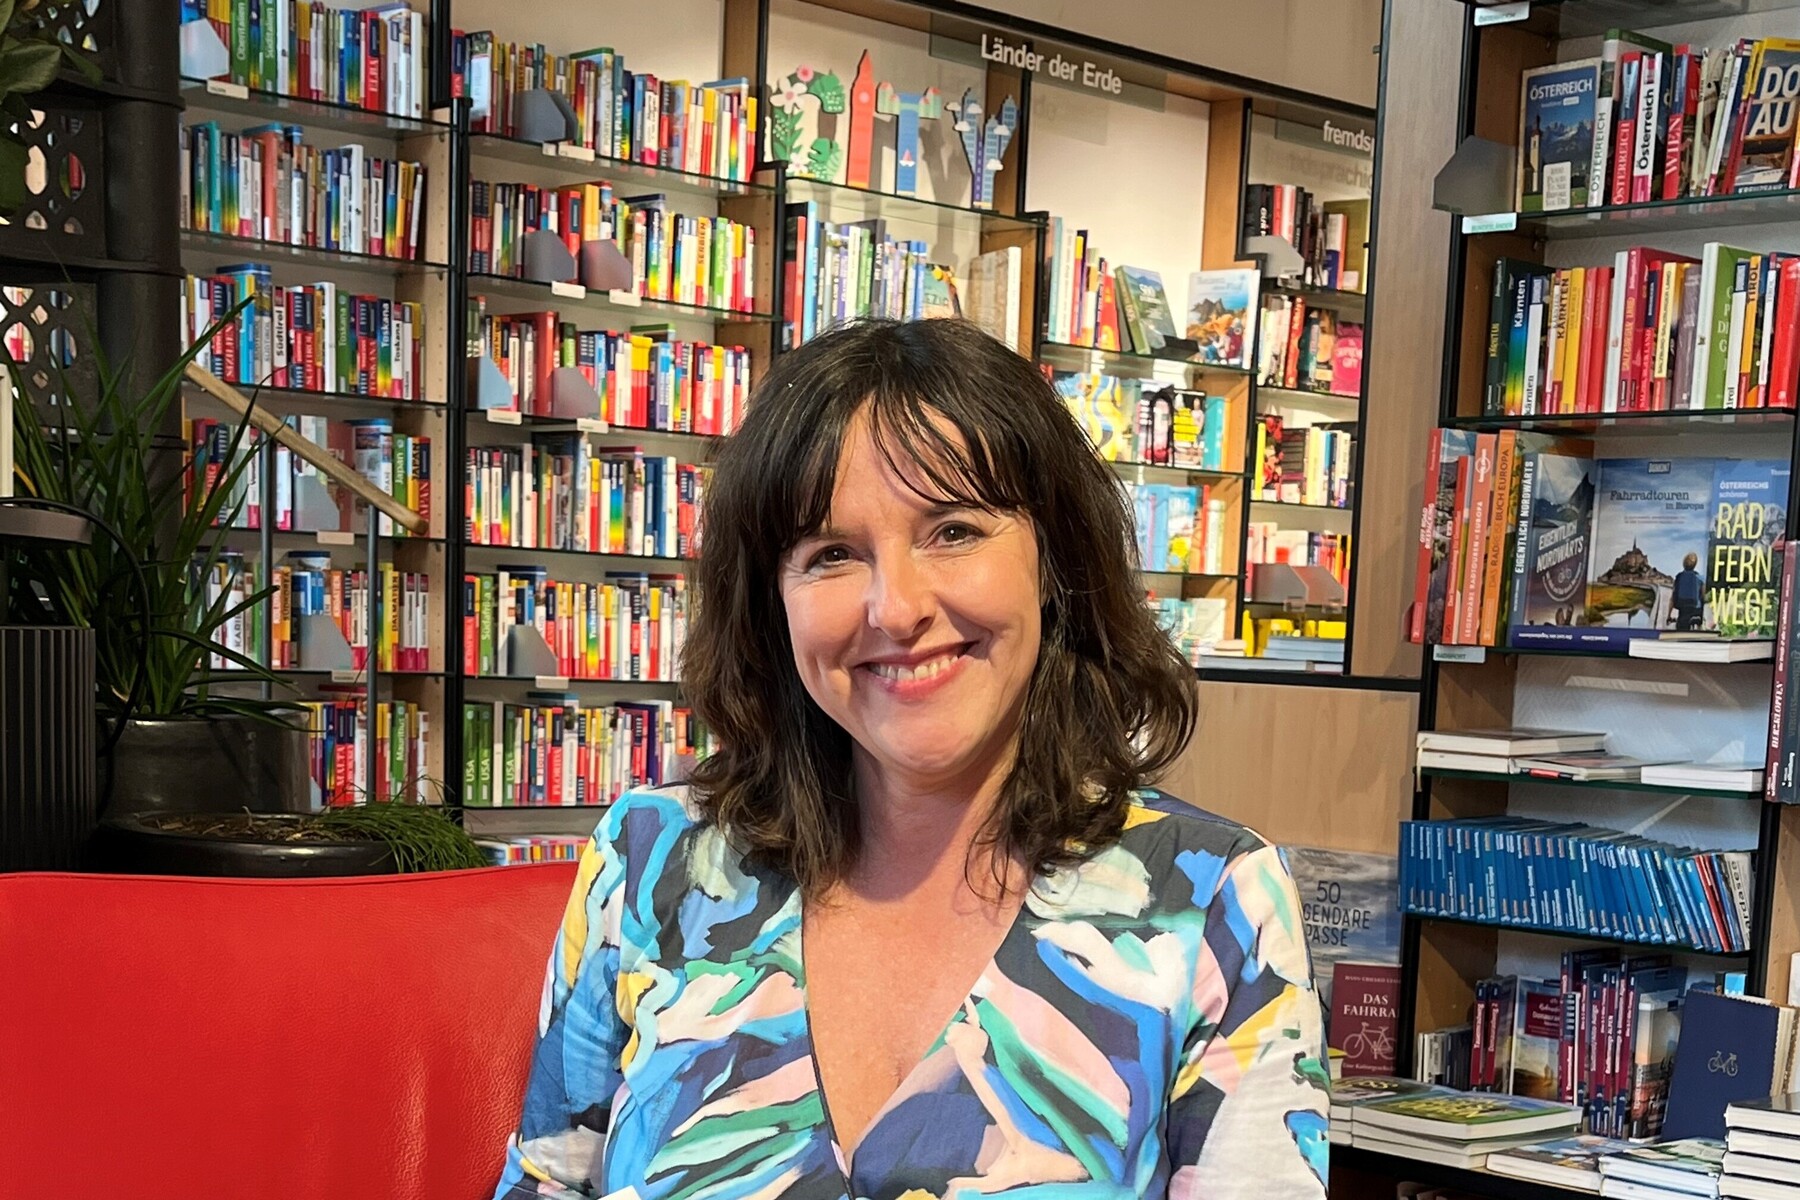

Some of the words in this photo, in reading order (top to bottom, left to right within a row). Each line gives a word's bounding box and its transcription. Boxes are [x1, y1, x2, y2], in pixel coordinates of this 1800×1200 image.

[236, 2, 247, 60] Oberitalien
[264, 7, 275, 59] Süditalien
[368, 58, 379, 93] ELBA
[981, 34, 1044, 71] Länder
[1048, 54, 1078, 81] der
[1083, 62, 1122, 94] Erde
[1760, 63, 1800, 100] DO
[1529, 78, 1593, 100] ÖSTERREICH
[1638, 87, 1654, 170] Österreich
[1749, 99, 1796, 136] AU
[1591, 112, 1606, 192] ÖSTERREICH
[1614, 121, 1631, 205] ÖSTERREICH
[1665, 117, 1682, 176] WIEN
[698, 221, 707, 265] SERBIEN
[1514, 279, 1526, 328] Kärnten
[1747, 262, 1759, 304] TIROL
[337, 306, 348, 347] Toskana
[380, 302, 390, 348] Toskana
[1556, 277, 1570, 340] KÄRNTEN
[225, 325, 235, 378] SIZILIEN
[275, 309, 284, 357] Südtirol
[369, 339, 377, 391] TOSKANA
[394, 451, 405, 486] Japan
[411, 442, 420, 482] JAPAN
[1499, 449, 1510, 491] EUROPA
[1519, 461, 1534, 517] NORDWÄRTS
[1609, 489, 1690, 501] Fahrradtouren
[1675, 501, 1704, 511] Europa
[1719, 481, 1769, 490] ÖSTERREICHS
[1474, 501, 1483, 533] EUROPA
[1716, 501, 1764, 540] RAD
[1469, 541, 1480, 589] RADTOUREN
[1514, 519, 1529, 574] EIGENTLICH
[1536, 535, 1584, 574] NORDWÄRTS
[1713, 545, 1773, 583] FERN
[391, 575, 399, 633] DALMATIEN
[481, 591, 491, 641] Südafrika
[588, 588, 597, 640] Tschechien
[1464, 592, 1476, 638] LEGENDÄRE
[1711, 587, 1776, 626] WEGE
[336, 745, 346, 787] MALTA
[466, 759, 476, 783] USA
[481, 758, 490, 782] USA
[506, 759, 515, 782] USA
[552, 747, 562, 797] FLORIDA
[1316, 880, 1341, 904] 50
[1303, 904, 1371, 930] GENDÄRE
[1307, 923, 1348, 947] PÄSSE
[1343, 1004, 1399, 1019] FAHRRA
[1363, 993, 1389, 1005] DAS
